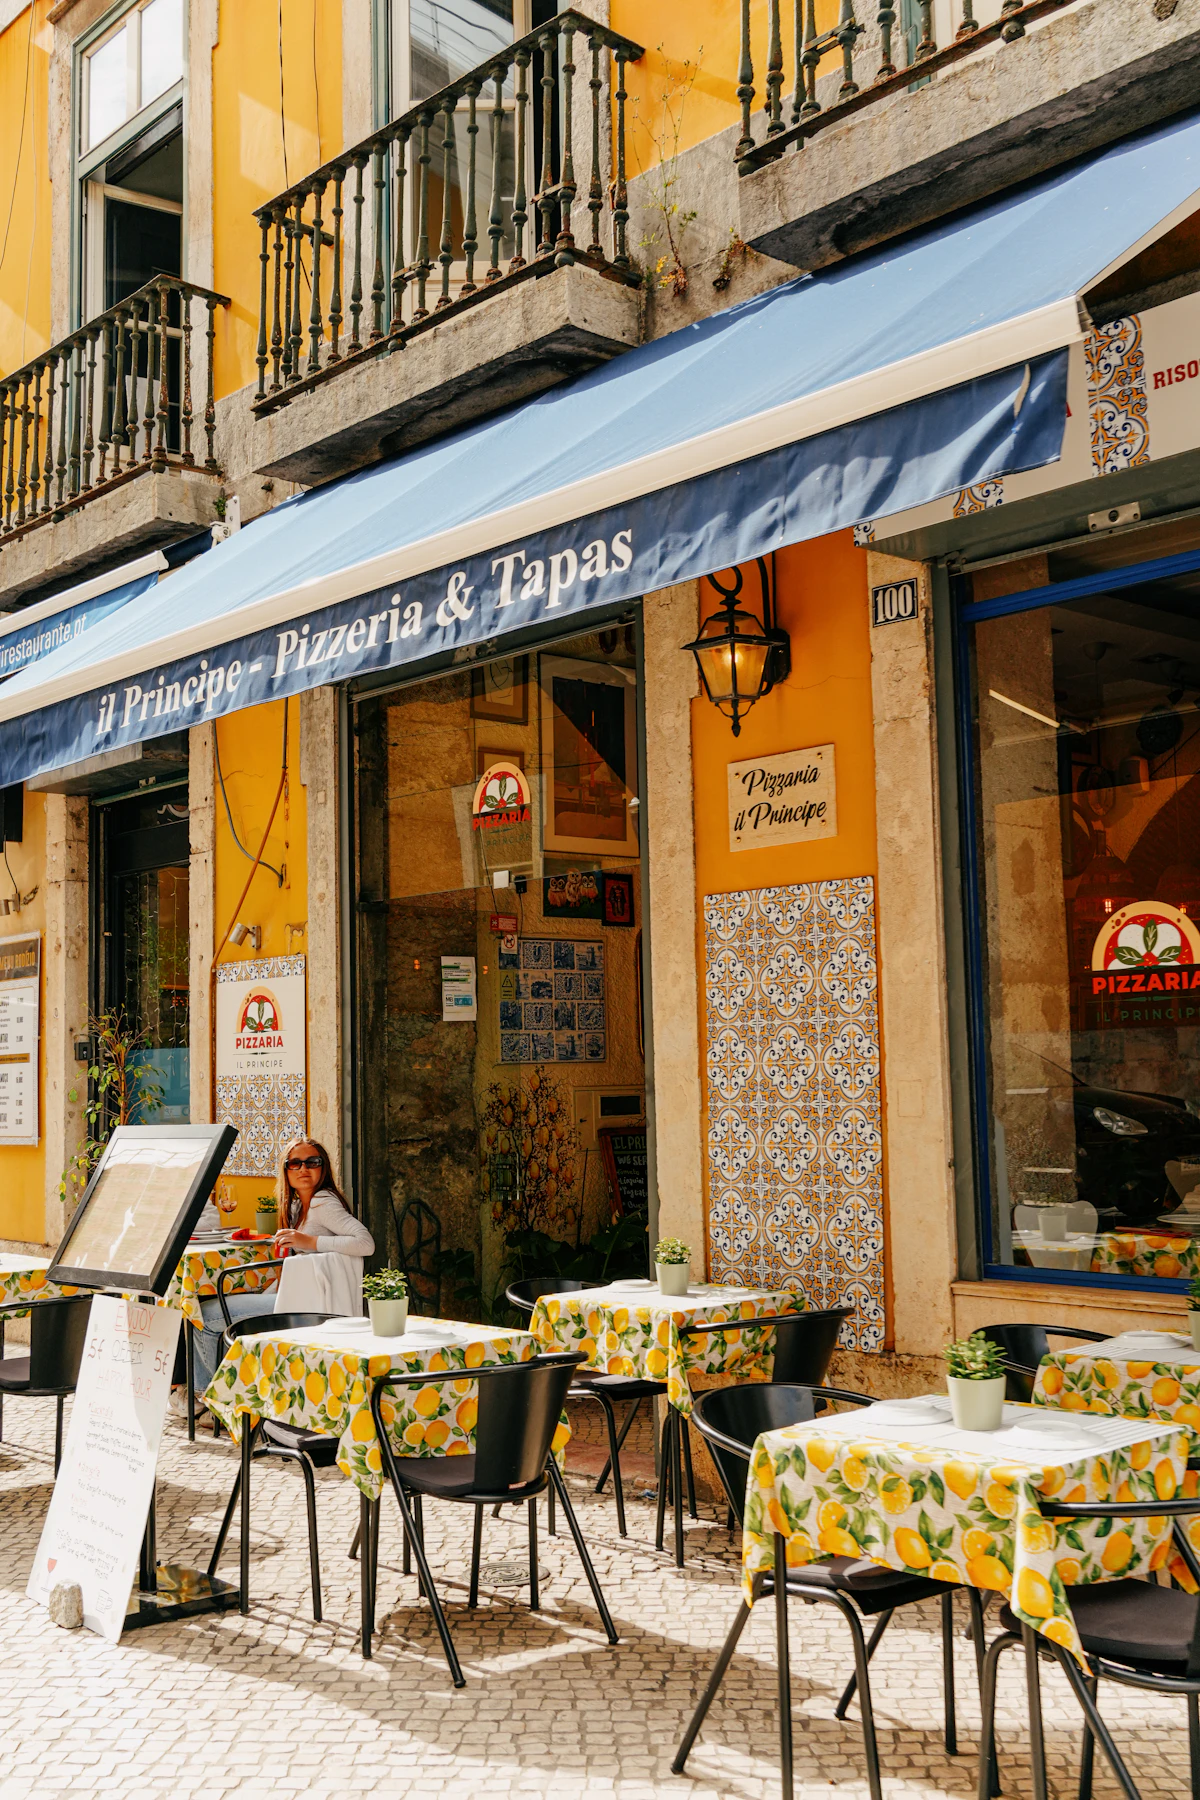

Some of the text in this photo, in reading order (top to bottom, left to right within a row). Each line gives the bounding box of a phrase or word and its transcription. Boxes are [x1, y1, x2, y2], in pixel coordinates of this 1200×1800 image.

[1152, 359, 1200, 390] RISO
[876, 584, 913, 623] 100
[0, 612, 87, 668] irestaurante.pt
[95, 692, 116, 736] il
[120, 659, 242, 728] Principe
[270, 592, 424, 679] Pizzeria
[435, 571, 475, 628] &
[491, 528, 633, 610] Tapas
[741, 764, 821, 797] Pizzaria
[472, 808, 531, 831] PIZZARIA
[748, 800, 828, 830] Principe
[1092, 971, 1200, 995] PIZZARIA
[1097, 1005, 1200, 1022] IL PRINCIP
[235, 1035, 284, 1049] PIZZARIA
[236, 1060, 283, 1069] IL PRINCIPE
[115, 1305, 156, 1333] ENJOY
[112, 1339, 144, 1362] OFFER
